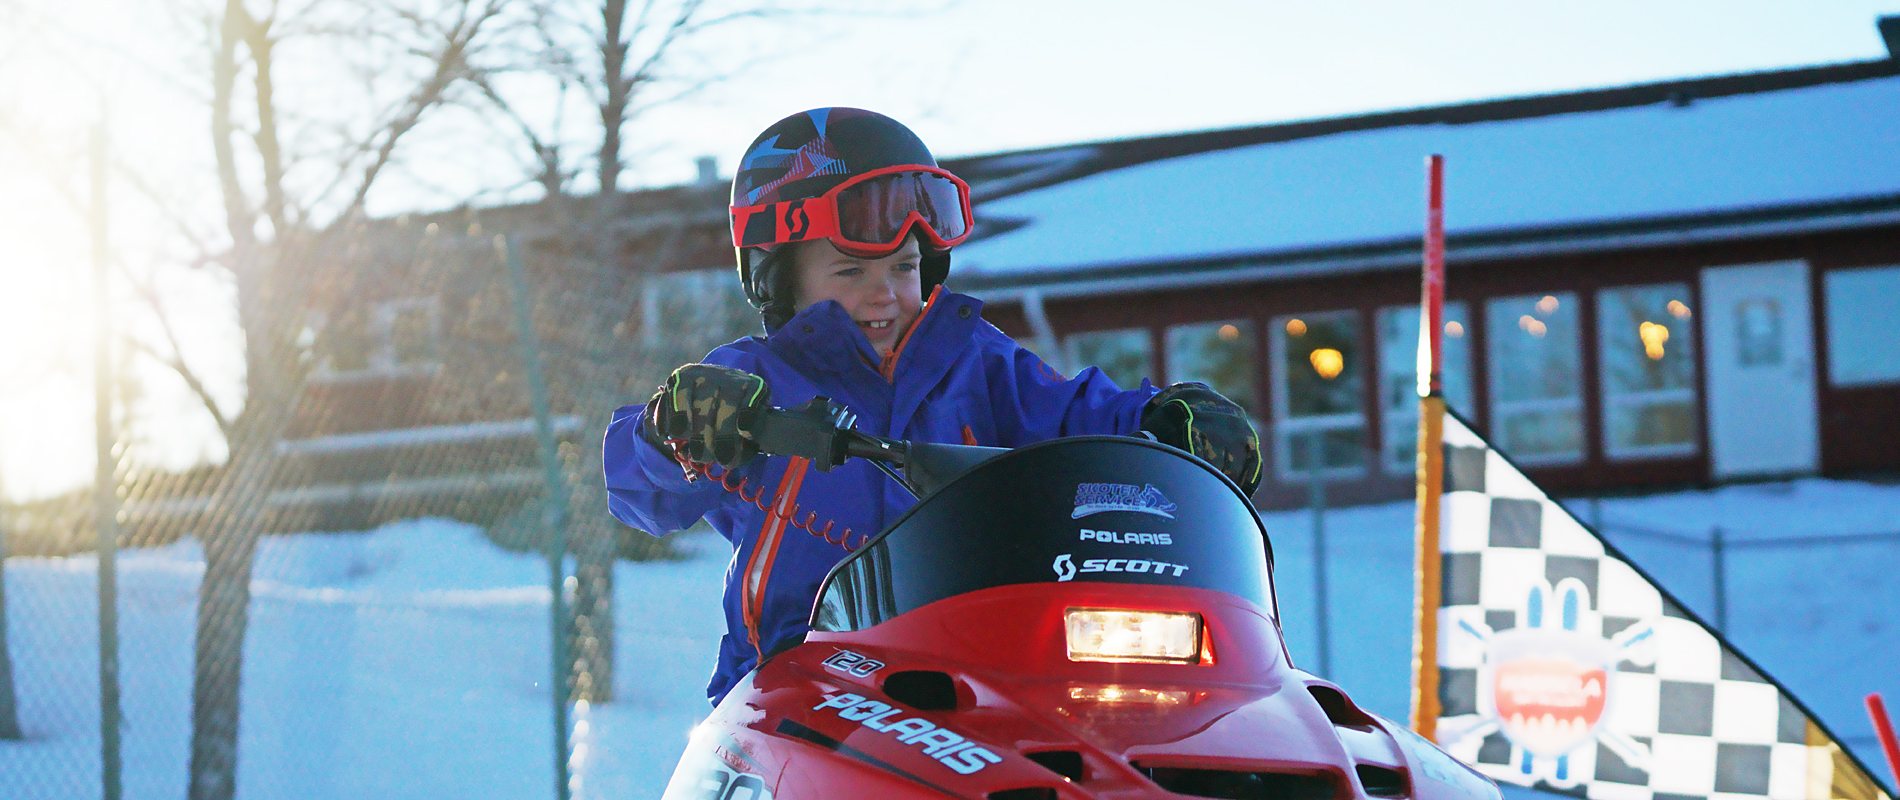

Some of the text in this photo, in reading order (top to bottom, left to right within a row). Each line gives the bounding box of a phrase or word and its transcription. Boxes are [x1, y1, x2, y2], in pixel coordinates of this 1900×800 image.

[1077, 483, 1140, 496] SKOTER
[1074, 494, 1141, 506] SERVICE
[1079, 529, 1173, 545] POLARIS
[1079, 559, 1189, 577] SCOTT
[821, 650, 885, 678] 120
[813, 693, 1003, 775] POLARIS
